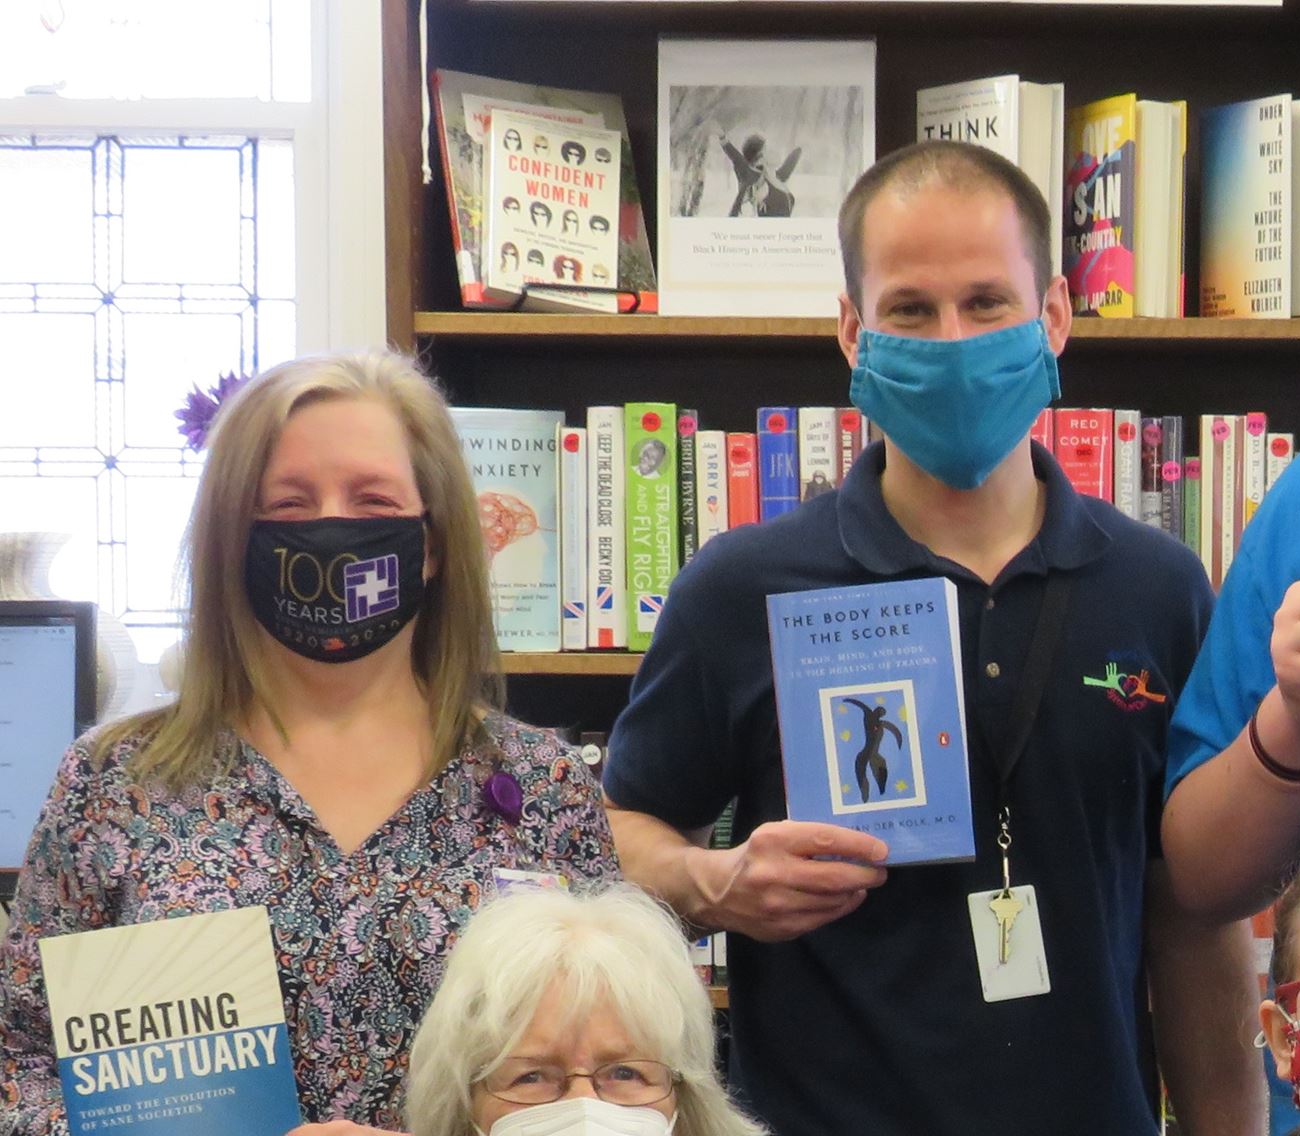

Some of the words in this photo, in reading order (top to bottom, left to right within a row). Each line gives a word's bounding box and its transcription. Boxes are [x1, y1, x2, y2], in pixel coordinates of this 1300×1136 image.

[1260, 104, 1283, 121] UNDER
[924, 115, 998, 140] THINK
[1082, 115, 1123, 163] OVE
[1278, 123, 1283, 136] A
[1259, 141, 1283, 157] WHITE
[508, 154, 606, 190] CONFIDENT
[1268, 160, 1283, 174] SKY
[525, 180, 589, 208] WOMEN
[1093, 172, 1122, 221] AN
[1269, 192, 1283, 206] THE
[1254, 208, 1283, 226] NATURE
[1257, 230, 1266, 244] OF
[1269, 228, 1283, 243] THE
[1255, 246, 1283, 262] FUTURE
[1244, 277, 1283, 296] ELIZABETH
[1251, 296, 1283, 313] KOLBERT
[1070, 418, 1099, 429] RED
[462, 438, 557, 452] WINDING
[1060, 436, 1108, 446] COMET
[597, 456, 613, 473] THE
[770, 453, 794, 478] JFK
[597, 473, 613, 498] DEAD
[636, 484, 647, 513] AND
[682, 480, 694, 526] BYRNE
[597, 499, 613, 527] CLOSE
[633, 516, 652, 547] FLY
[655, 484, 671, 589] STRAIGHTEN
[598, 536, 613, 567] BECKY
[273, 596, 343, 624] YEARS
[783, 614, 814, 628] THE
[823, 607, 871, 624] BODY
[881, 602, 935, 618] KEEPS
[810, 631, 843, 645] THE
[852, 624, 911, 640] SCORE
[873, 648, 894, 658] AND
[897, 645, 924, 655] BODY
[806, 668, 825, 678] THE
[829, 664, 875, 676] HEALING
[896, 657, 938, 668] TRAUMA
[874, 820, 894, 831] DER
[65, 991, 240, 1054] CREATING
[71, 1026, 279, 1096] SANCTUARY
[79, 1103, 131, 1120] TOWARD
[137, 1097, 161, 1110] THE
[165, 1087, 236, 1105] EVOLUTION
[81, 1121, 97, 1131] OF
[102, 1115, 134, 1128] SANE
[137, 1105, 203, 1121] SOCIETIES
